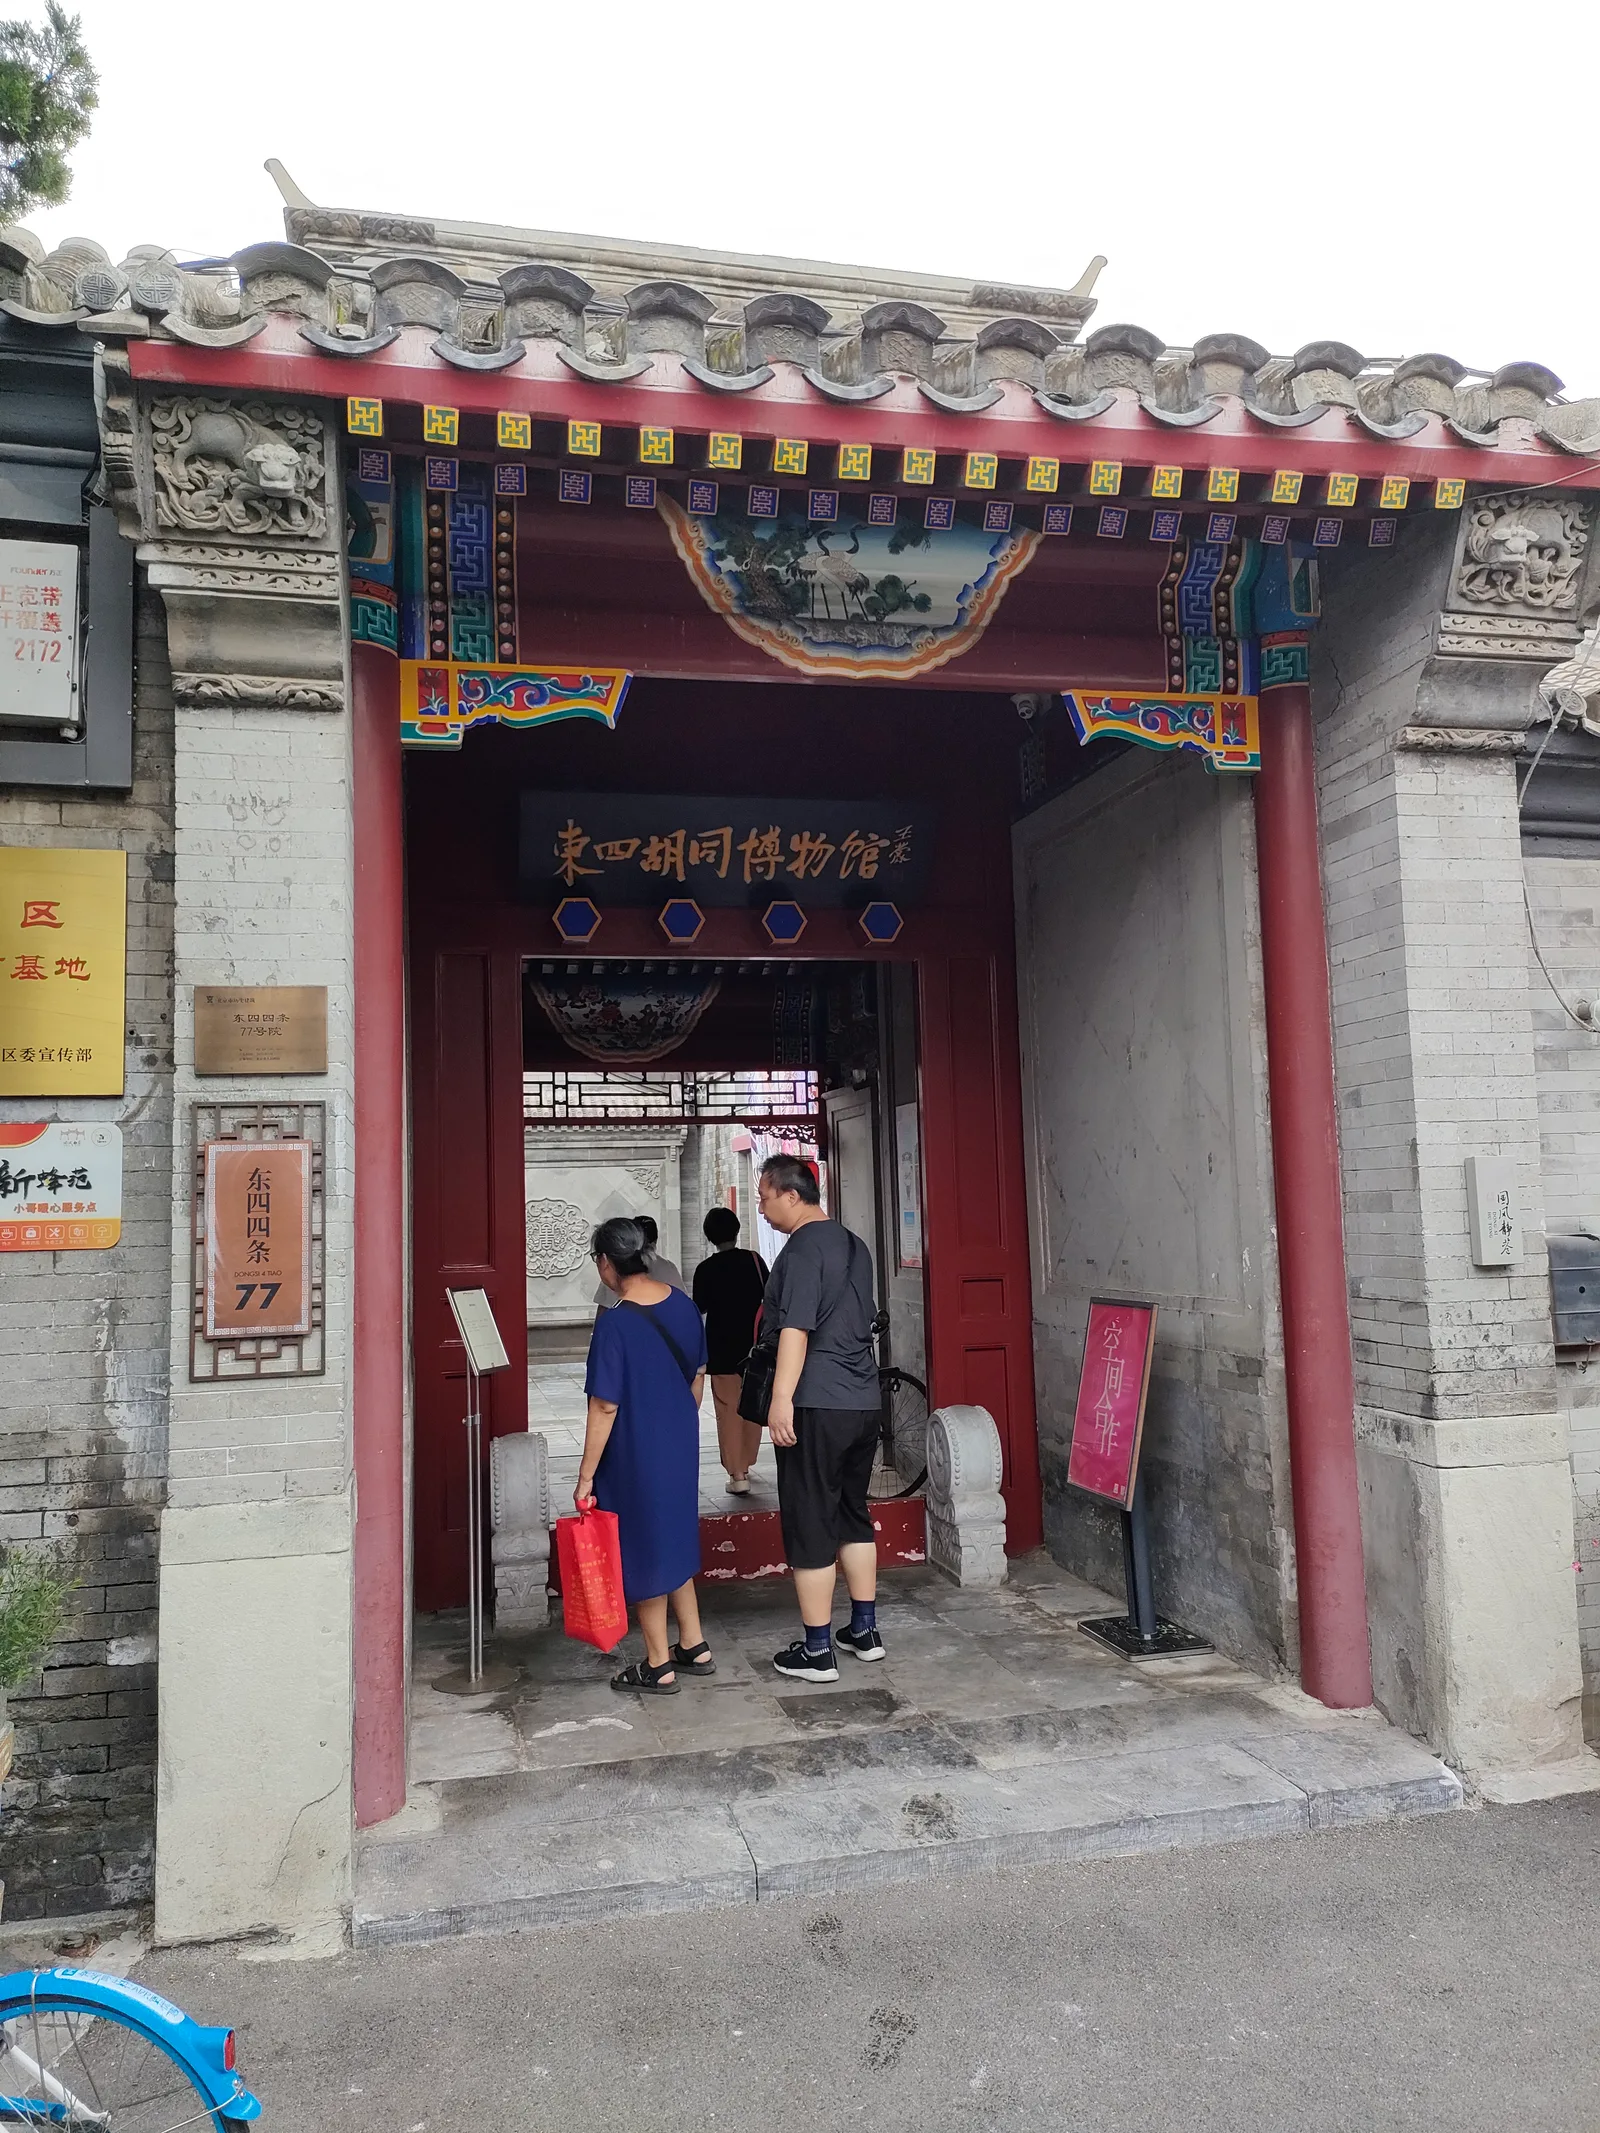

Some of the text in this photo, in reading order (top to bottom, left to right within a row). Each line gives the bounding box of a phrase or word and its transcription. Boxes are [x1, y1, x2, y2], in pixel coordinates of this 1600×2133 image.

[14, 637, 62, 663] 2172
[20, 901, 65, 929] 区
[0, 954, 91, 981] 基地
[233, 1013, 290, 1023] 东四四条
[240, 1026, 283, 1037] 77号院
[2, 1047, 93, 1063] 区委宣传部
[13, 1201, 98, 1214] 小哥暖心服务点
[246, 1167, 272, 1264] 东四四条
[234, 1270, 261, 1278] DONGSI
[234, 1282, 283, 1311] 77
